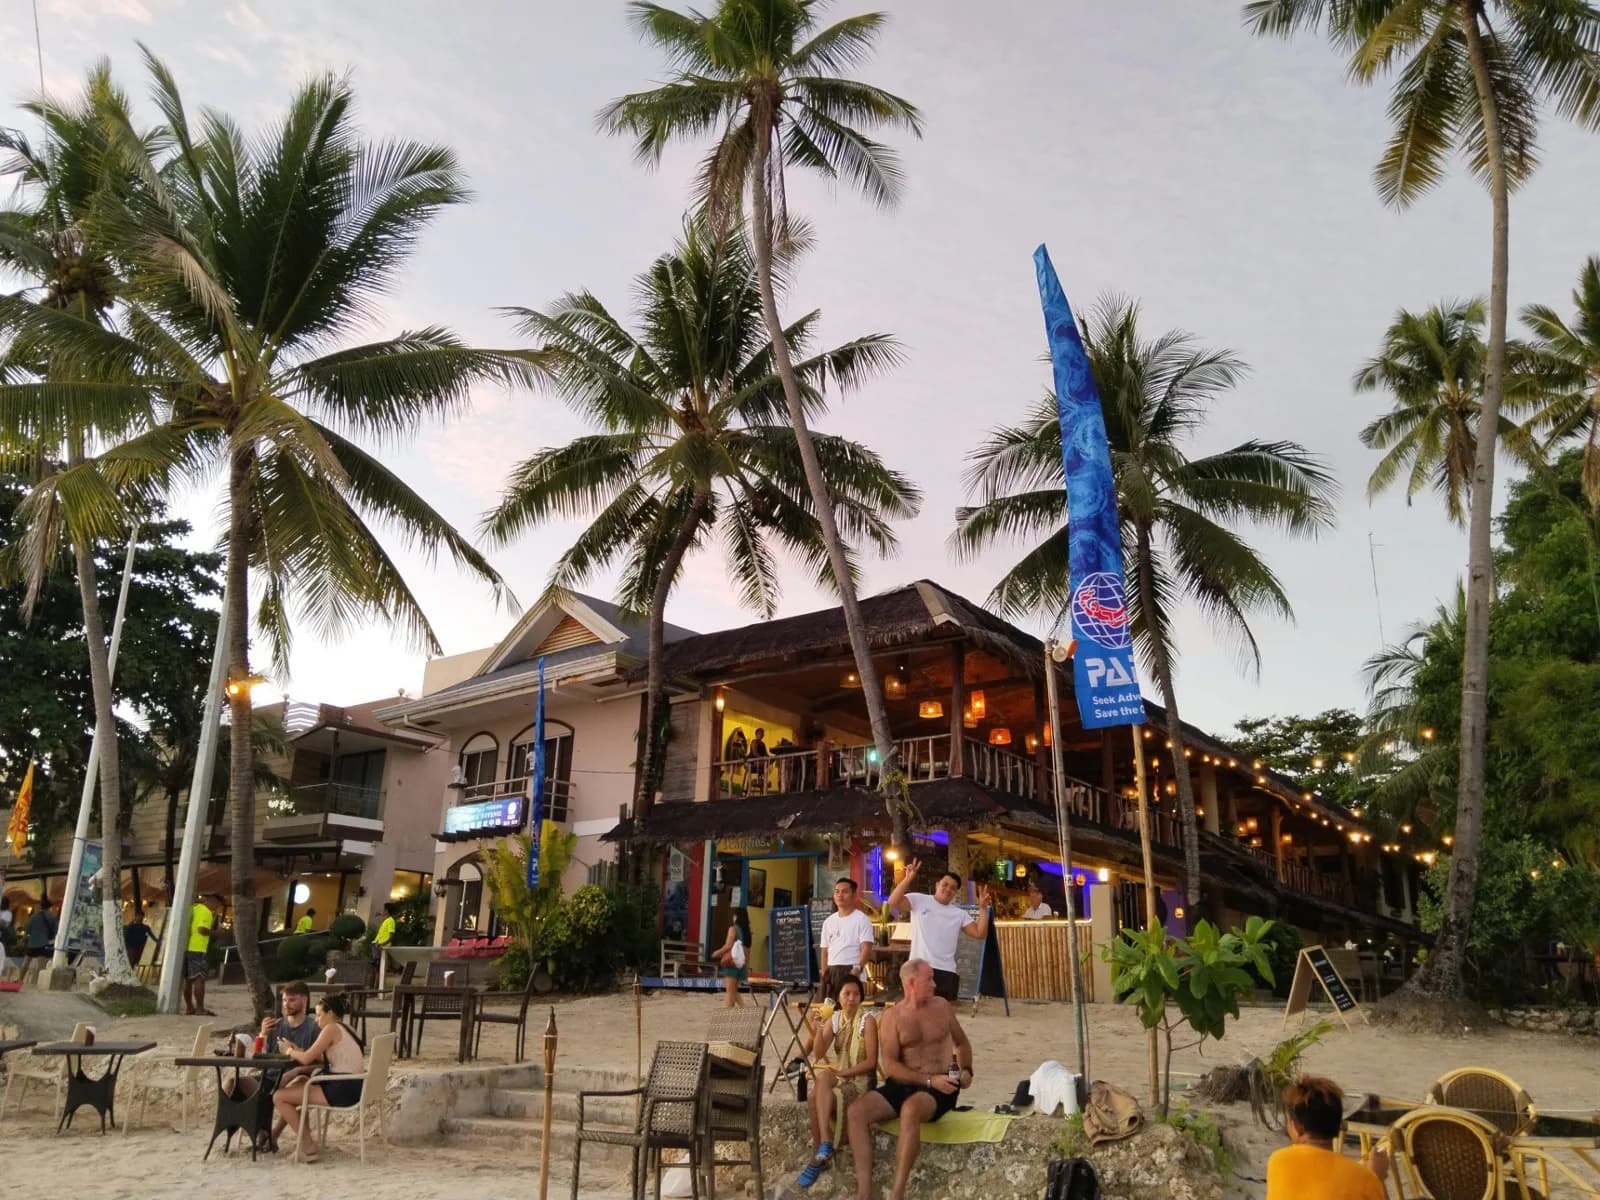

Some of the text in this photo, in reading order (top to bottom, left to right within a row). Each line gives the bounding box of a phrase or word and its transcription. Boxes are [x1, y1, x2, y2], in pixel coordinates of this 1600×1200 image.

[1092, 696, 1115, 705] Seek
[1095, 709, 1118, 718] Save
[1120, 706, 1138, 716] the
